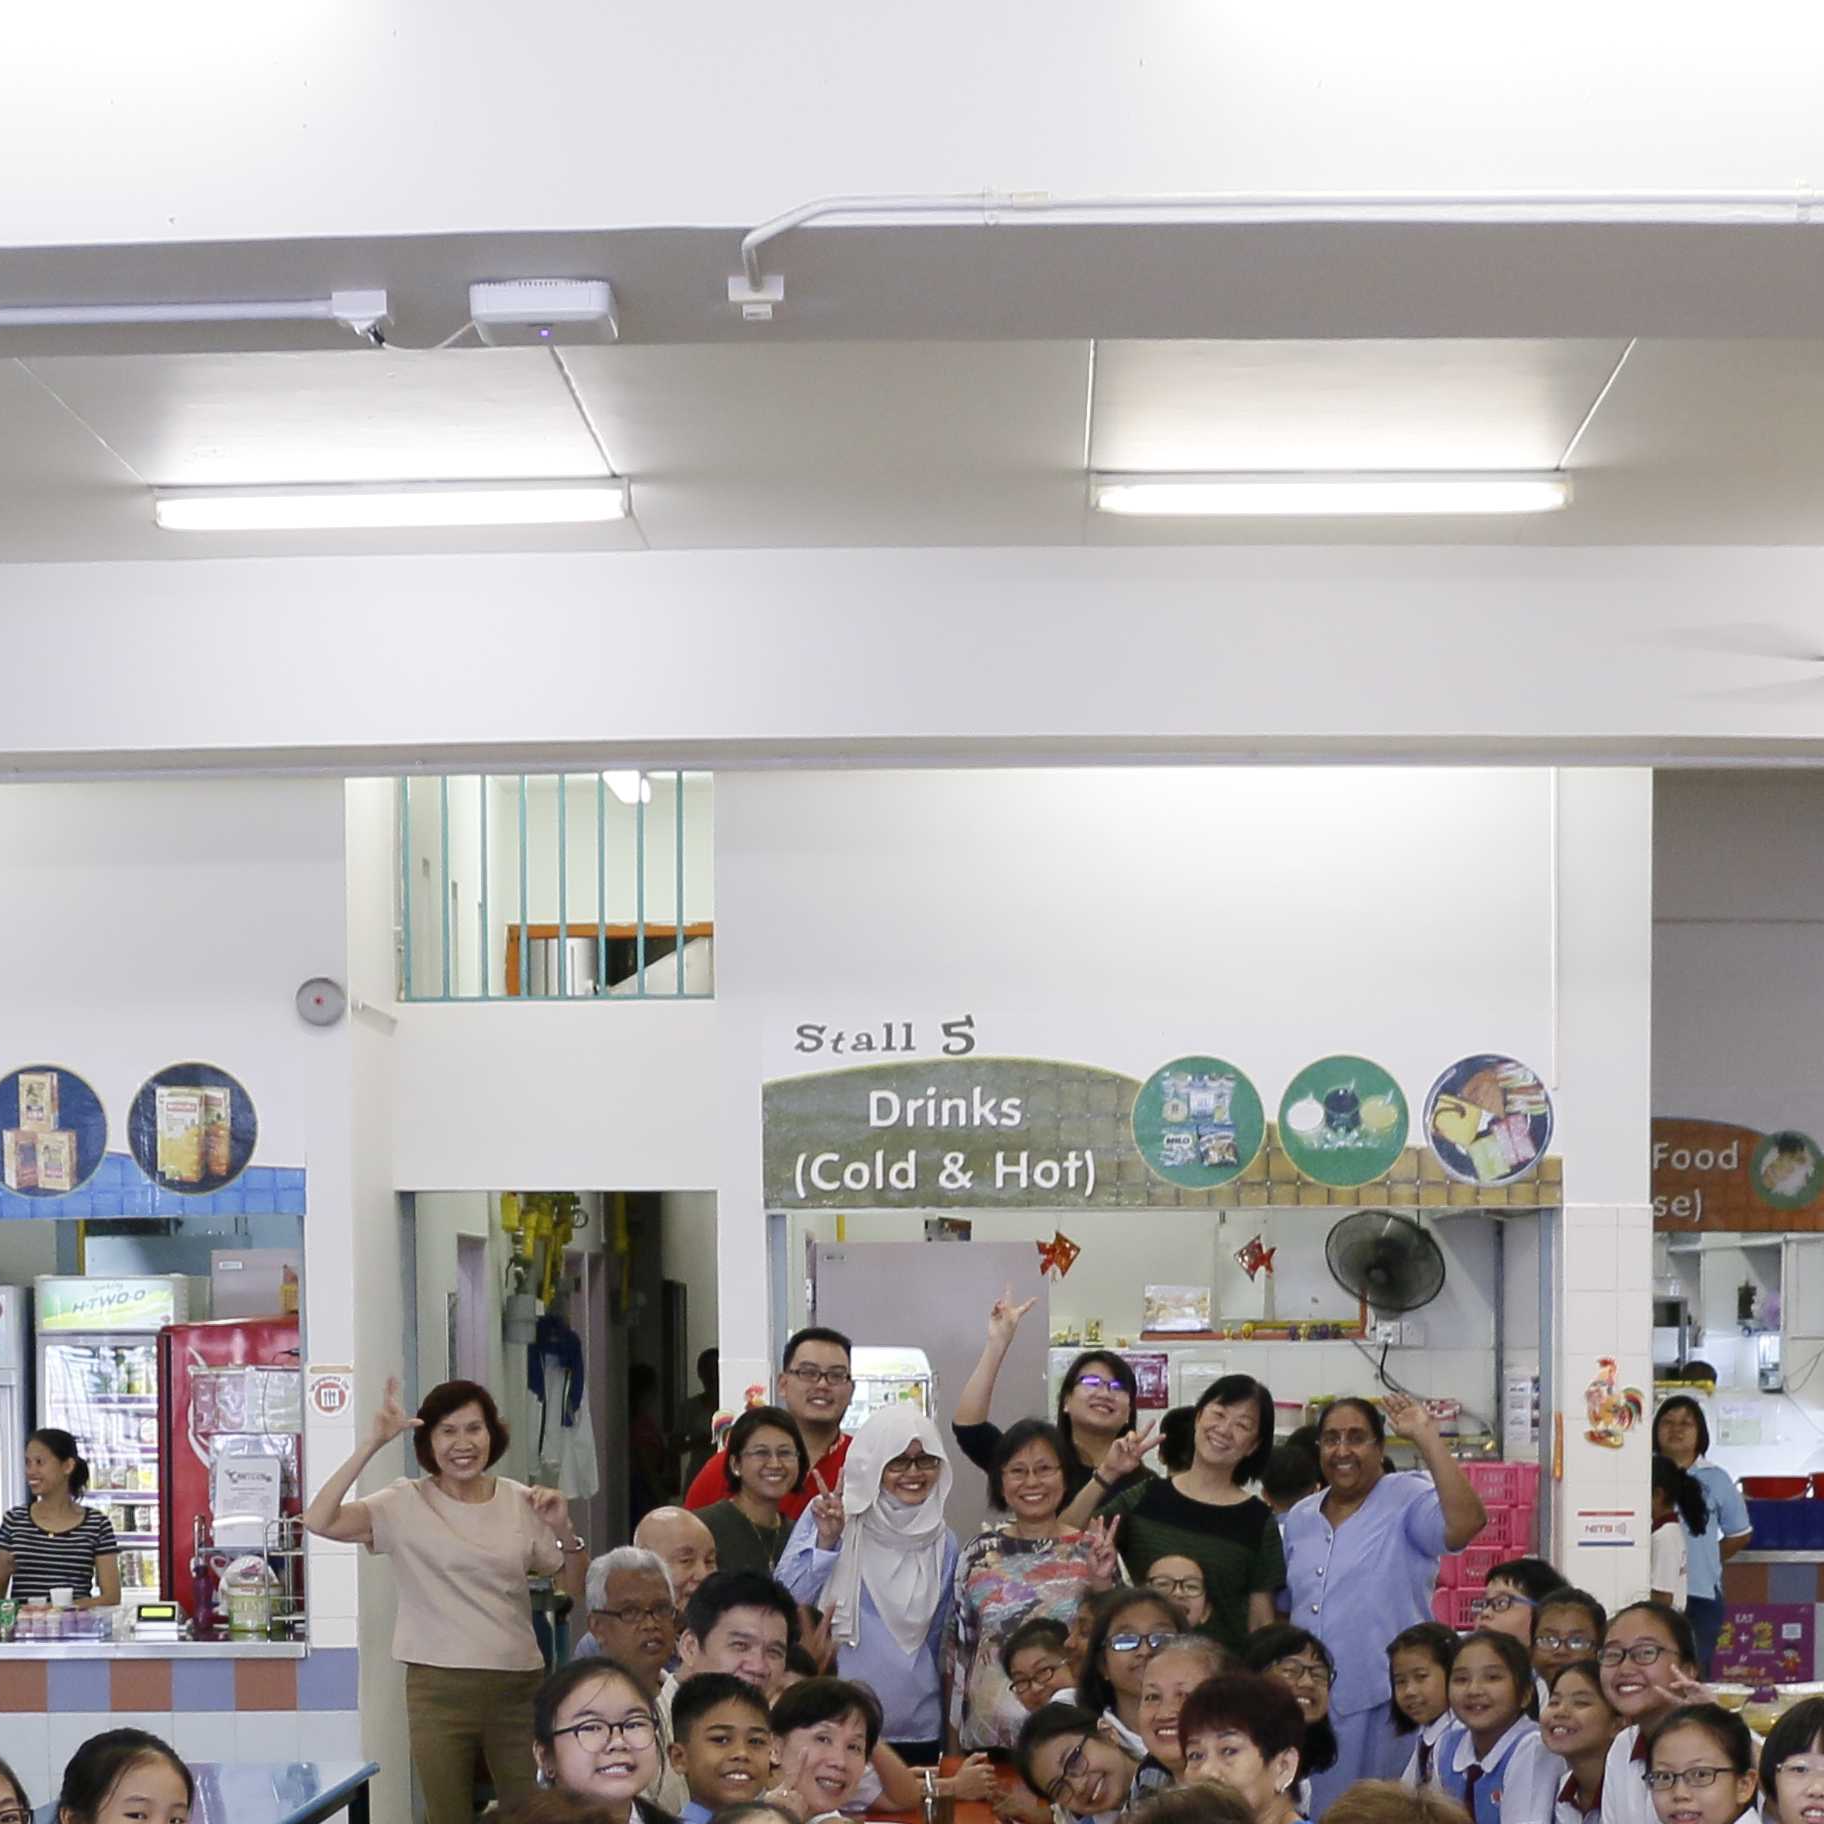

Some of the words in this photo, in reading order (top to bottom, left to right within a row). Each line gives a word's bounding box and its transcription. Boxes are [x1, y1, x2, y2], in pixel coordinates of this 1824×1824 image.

[794, 1022, 916, 1054] Stall
[940, 1013, 977, 1056] 5
[868, 1086, 1023, 1128] Drinks
[793, 1149, 917, 1199] (Cold
[937, 1150, 975, 1190] &
[994, 1149, 1096, 1198] Hot)
[1652, 1139, 1739, 1171] Food
